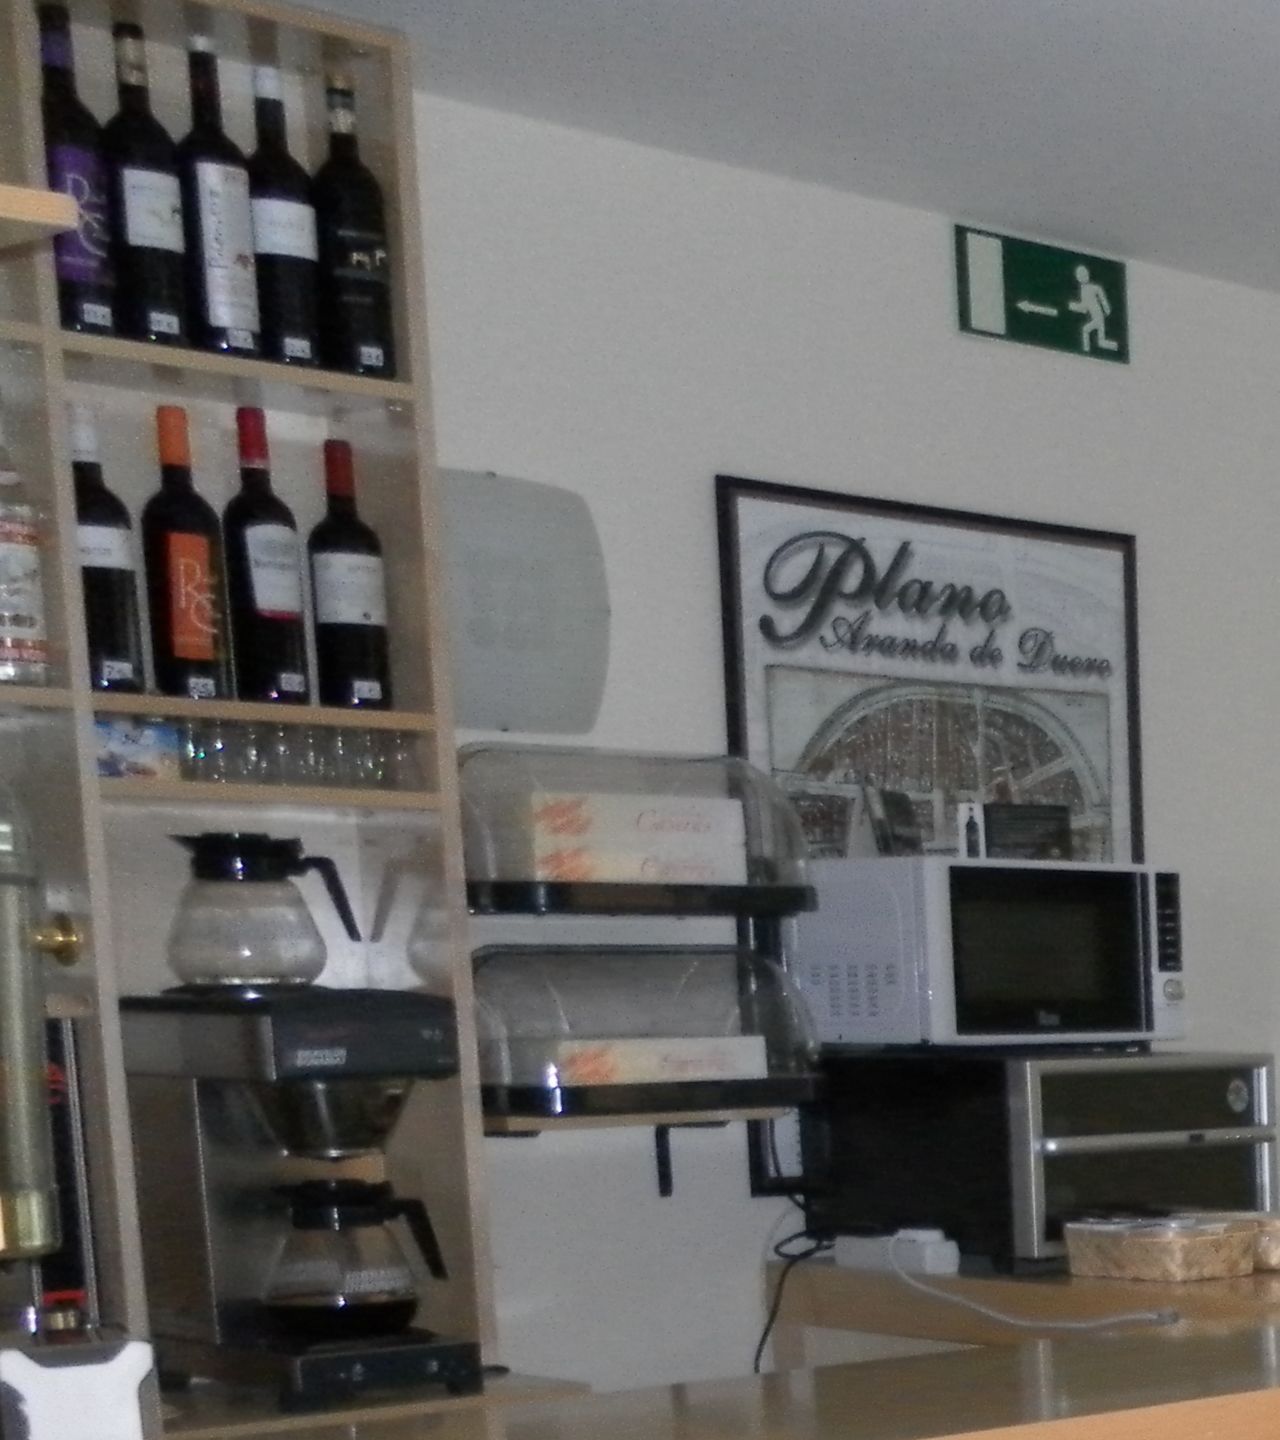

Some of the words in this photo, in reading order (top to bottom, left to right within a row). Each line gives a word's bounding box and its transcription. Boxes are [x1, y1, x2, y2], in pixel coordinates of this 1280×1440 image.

[759, 530, 1012, 645] Plano
[819, 610, 958, 660] Aranda
[969, 628, 1004, 669] de
[1016, 627, 1113, 678] Duero
